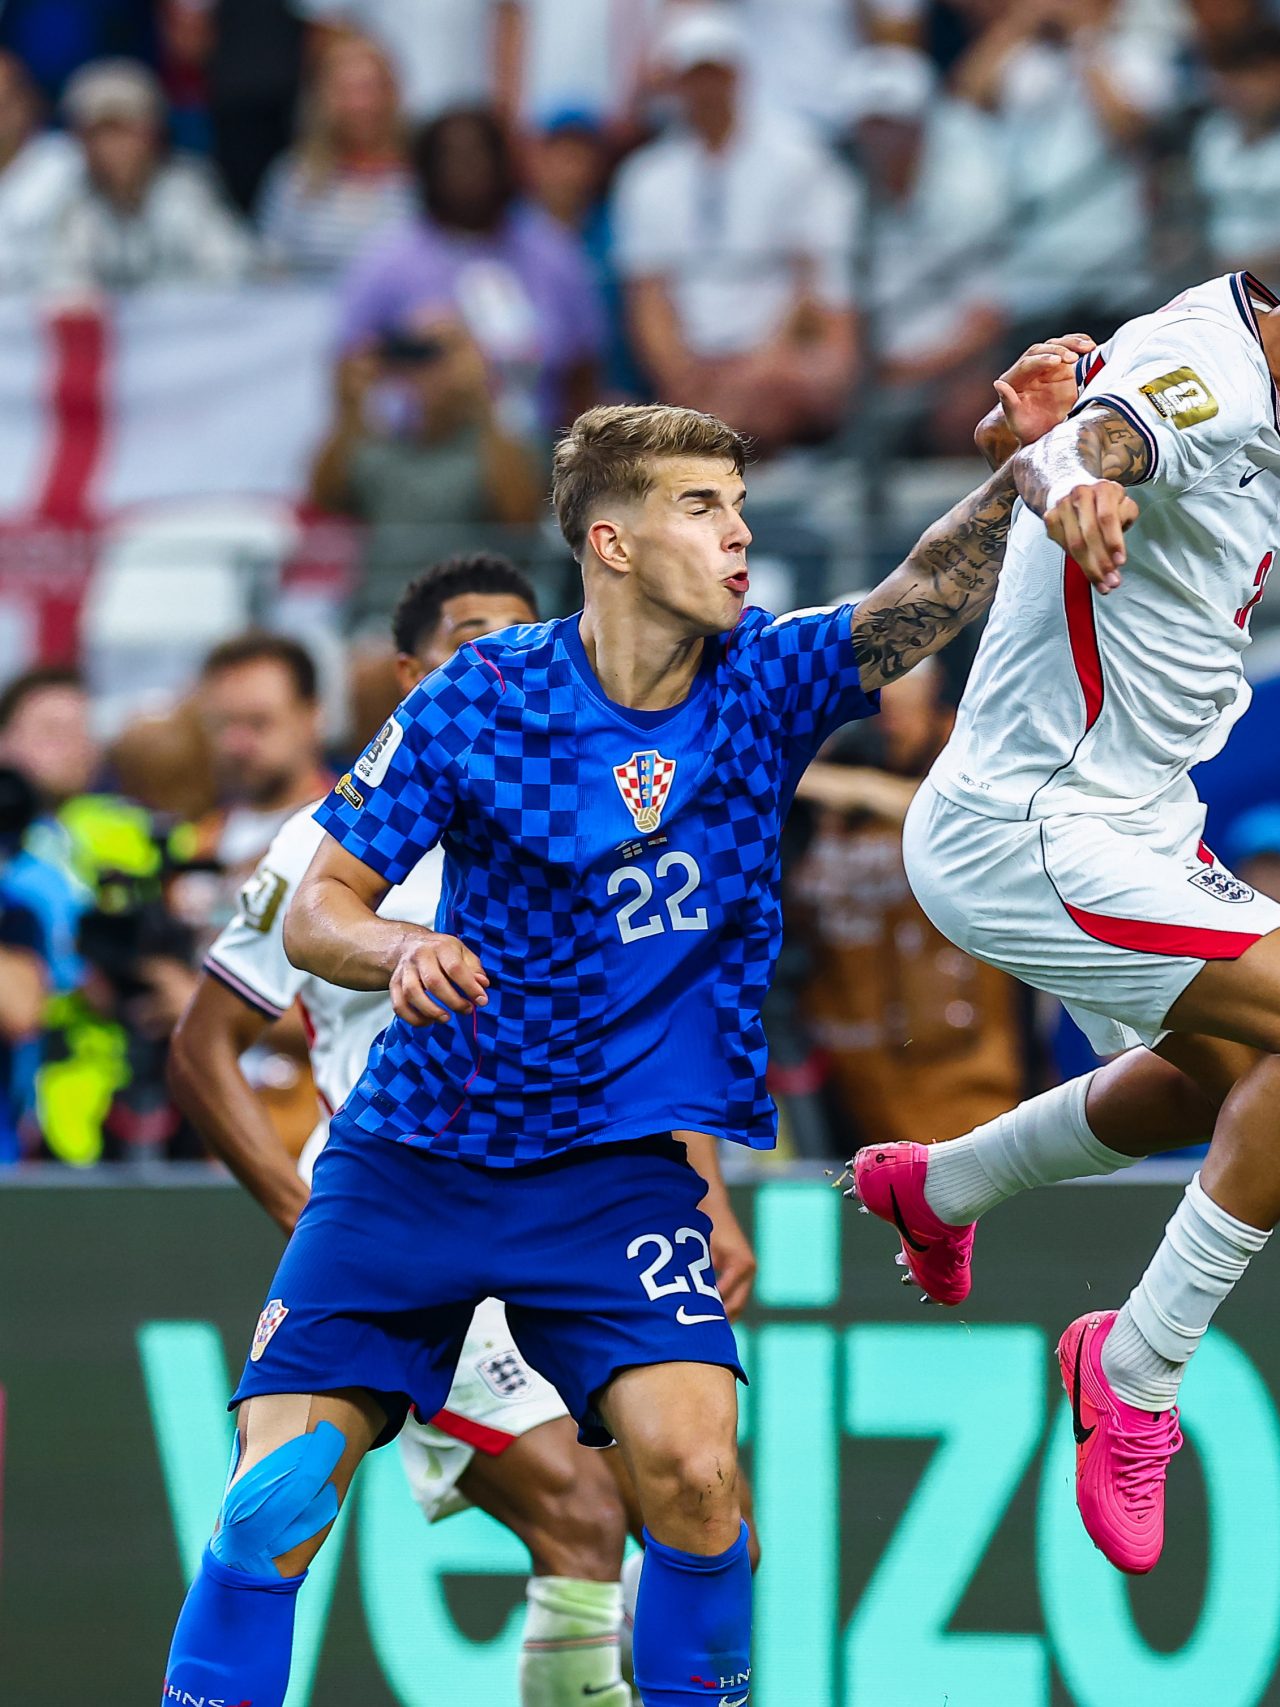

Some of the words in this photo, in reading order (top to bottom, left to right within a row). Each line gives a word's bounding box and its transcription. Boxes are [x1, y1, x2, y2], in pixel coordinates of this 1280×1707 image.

[640, 760, 651, 800] HNS
[607, 851, 709, 944] 22
[626, 1226, 724, 1302] 22
[720, 1668, 751, 1689] HN
